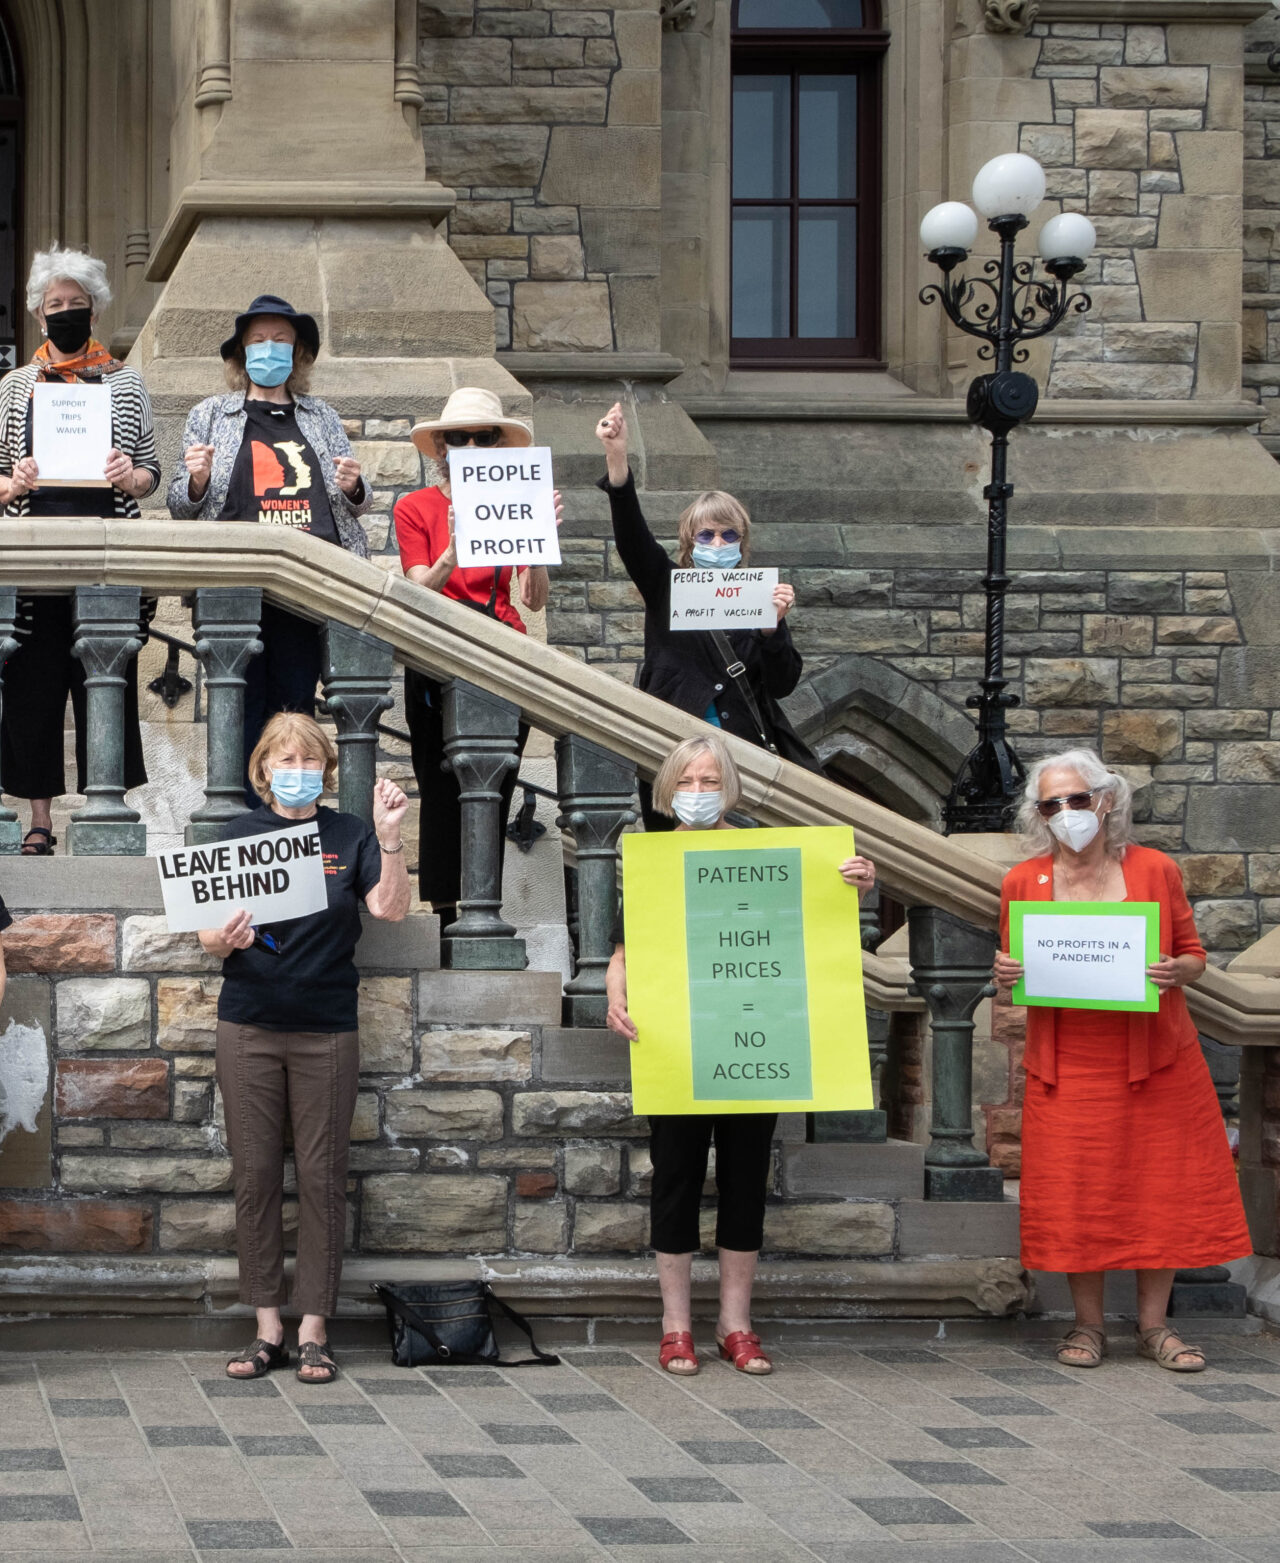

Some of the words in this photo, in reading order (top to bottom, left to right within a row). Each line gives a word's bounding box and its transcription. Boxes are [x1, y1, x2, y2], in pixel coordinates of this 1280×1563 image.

[462, 464, 541, 483] PEOPLE
[261, 500, 310, 511] WOMEN'S
[475, 504, 533, 520] OVER
[259, 509, 312, 525] MARCH
[470, 538, 545, 555] PROFIT
[673, 571, 714, 583] PEOPLE'S
[722, 572, 763, 581] VACCINE
[715, 586, 742, 598] NOT
[672, 610, 679, 618] A
[685, 608, 716, 617] PROFIT
[724, 608, 763, 616] VACCINE
[160, 846, 231, 879] LEAVE
[237, 833, 320, 867] NOONE
[698, 865, 789, 883] PATENTS
[192, 868, 290, 904] BEHIND
[719, 930, 770, 948] HIGH
[1037, 940, 1054, 948] NO
[1057, 940, 1105, 949] PROFITS
[1108, 941, 1119, 950] IN
[1122, 942, 1131, 950] A
[1052, 952, 1115, 963] PANDEMIC!
[712, 961, 782, 979] PRICES
[734, 1031, 766, 1048] NO
[713, 1063, 790, 1080] ACCESS
